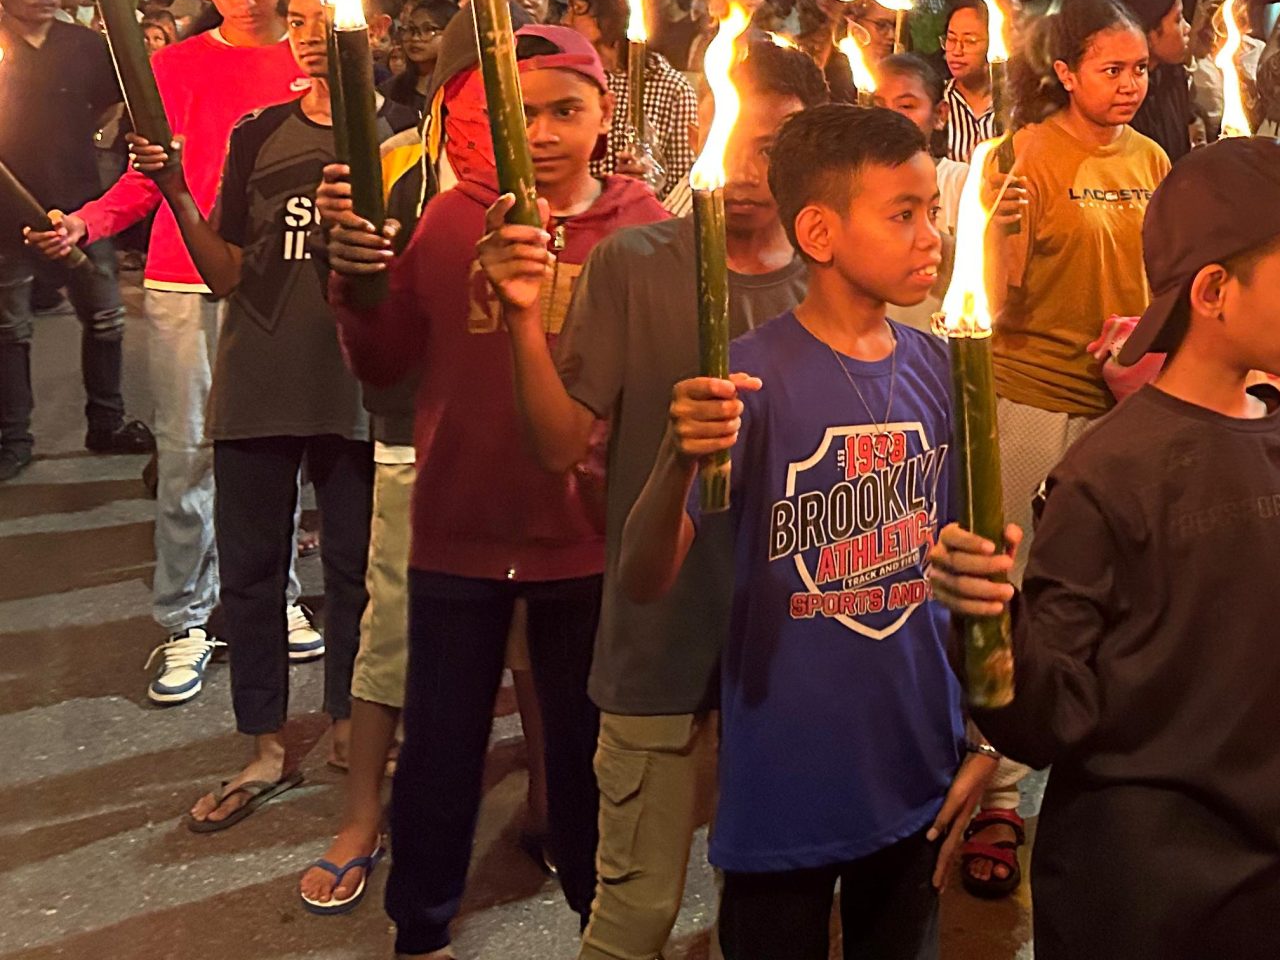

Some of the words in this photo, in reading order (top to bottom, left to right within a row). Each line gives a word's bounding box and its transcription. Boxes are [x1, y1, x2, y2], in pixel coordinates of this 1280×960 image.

[845, 431, 907, 481] 1978
[847, 569, 877, 587] TRACK
[879, 562, 899, 576] AND
[790, 586, 883, 619] SPORTS
[888, 581, 927, 609] AND
